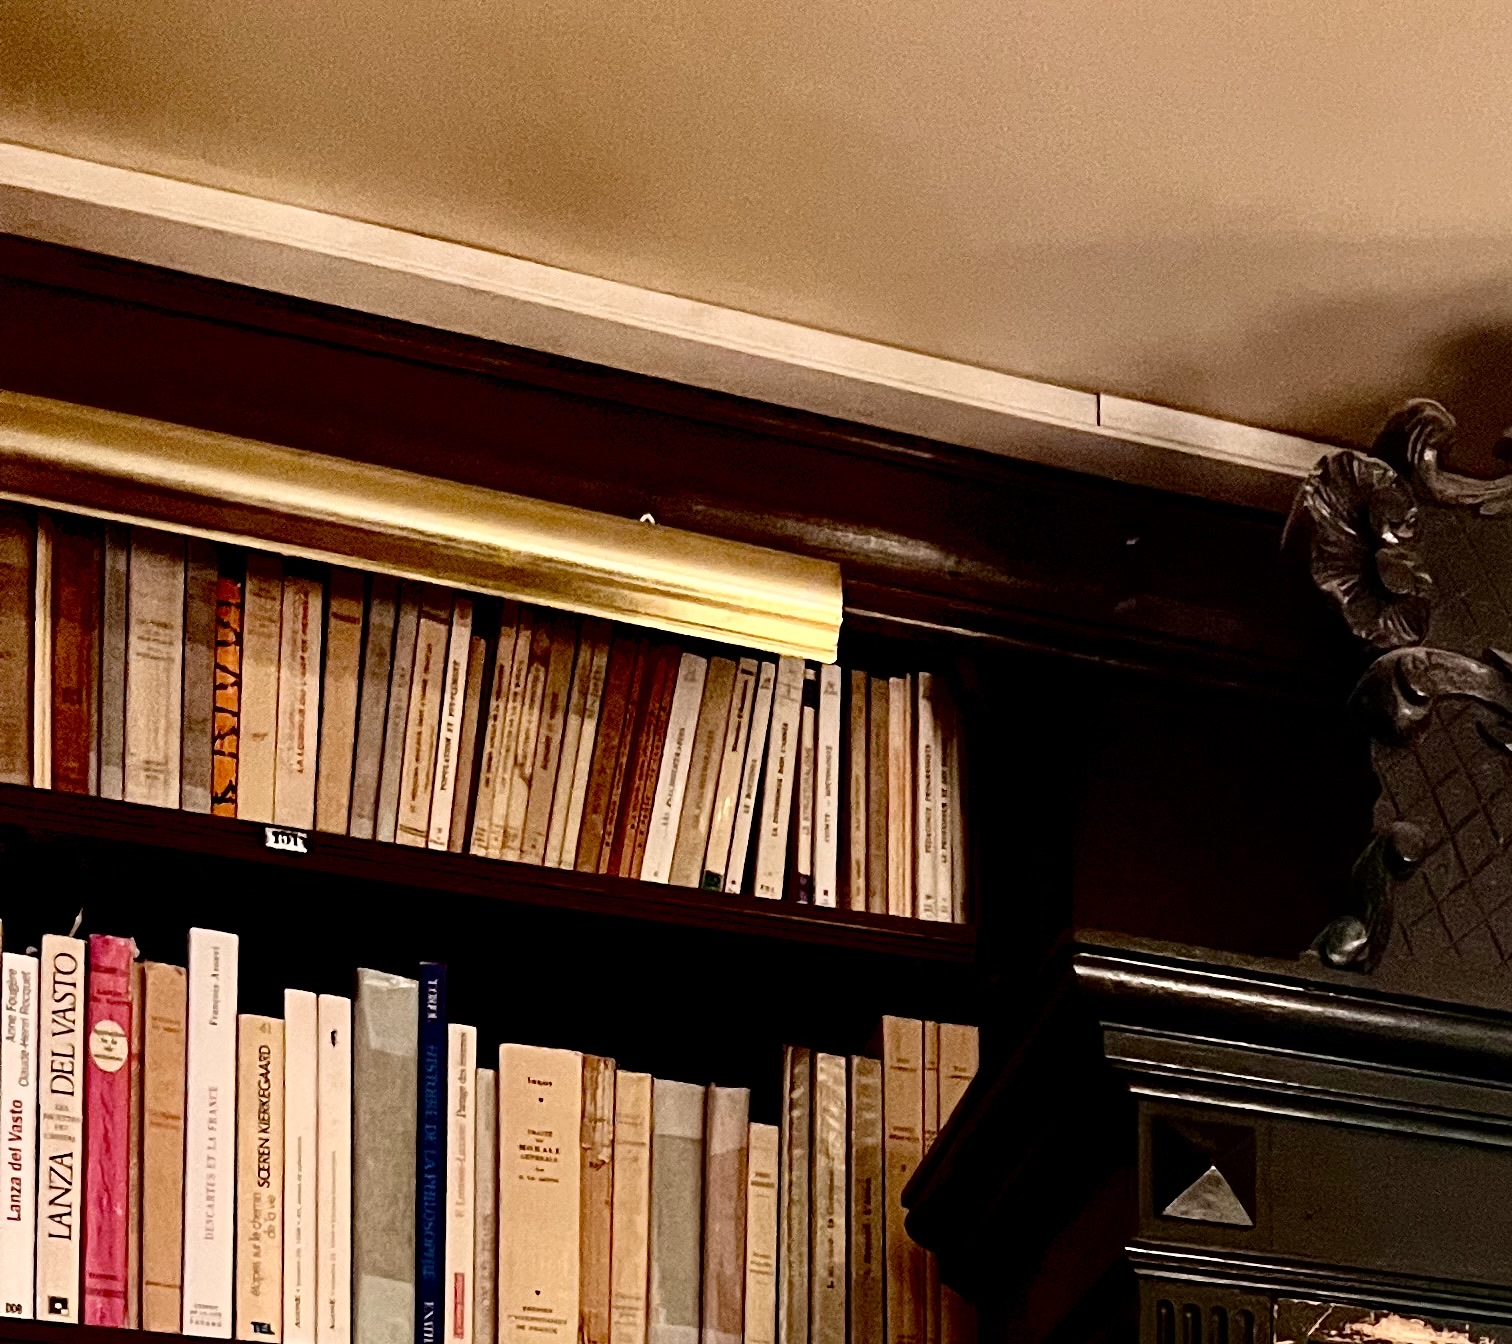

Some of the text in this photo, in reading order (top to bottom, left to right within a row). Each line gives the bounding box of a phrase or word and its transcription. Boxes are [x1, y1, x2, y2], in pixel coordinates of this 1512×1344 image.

[7, 1014, 17, 1043] Anne
[51, 952, 78, 1039] VASTO
[50, 1045, 75, 1097] DEL
[257, 1045, 272, 1135] KIERKEGAARD
[6, 1100, 23, 1222] Lanza del Vasto
[48, 1152, 74, 1241] LANZA
[204, 1086, 219, 1241] DESCARTES ET LA FRANCE
